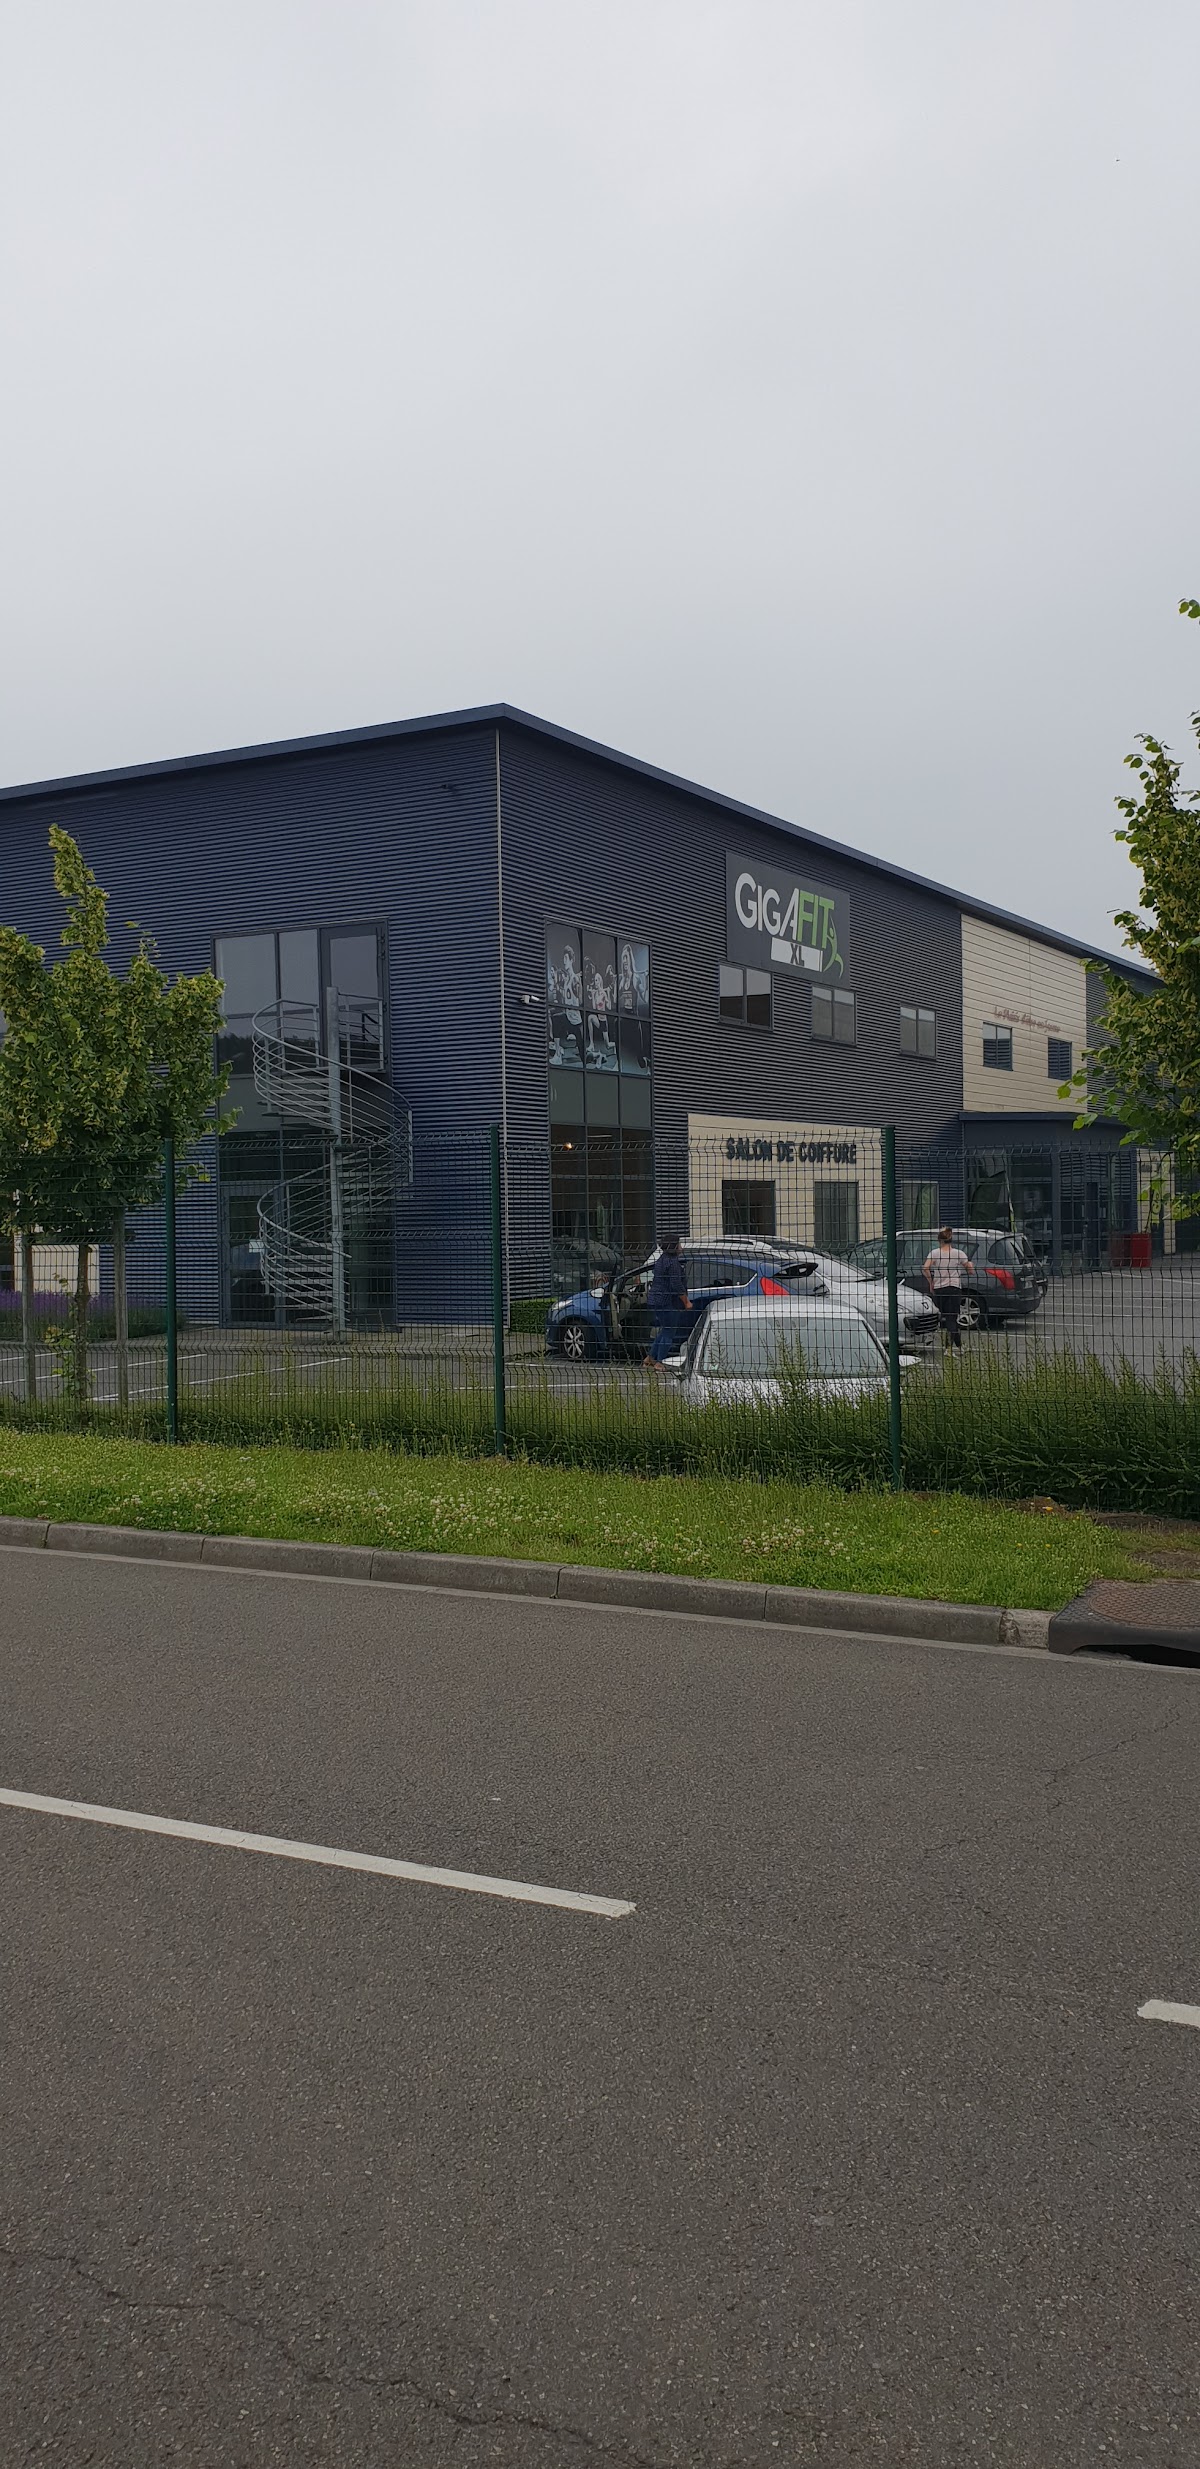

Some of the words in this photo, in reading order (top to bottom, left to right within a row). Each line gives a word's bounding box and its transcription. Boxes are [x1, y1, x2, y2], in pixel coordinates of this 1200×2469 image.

[734, 872, 835, 950] GIGAFIT
[790, 943, 805, 967] XL
[726, 1137, 773, 1162] SALON
[776, 1140, 795, 1163] DE
[799, 1141, 857, 1165] COIFFURE
